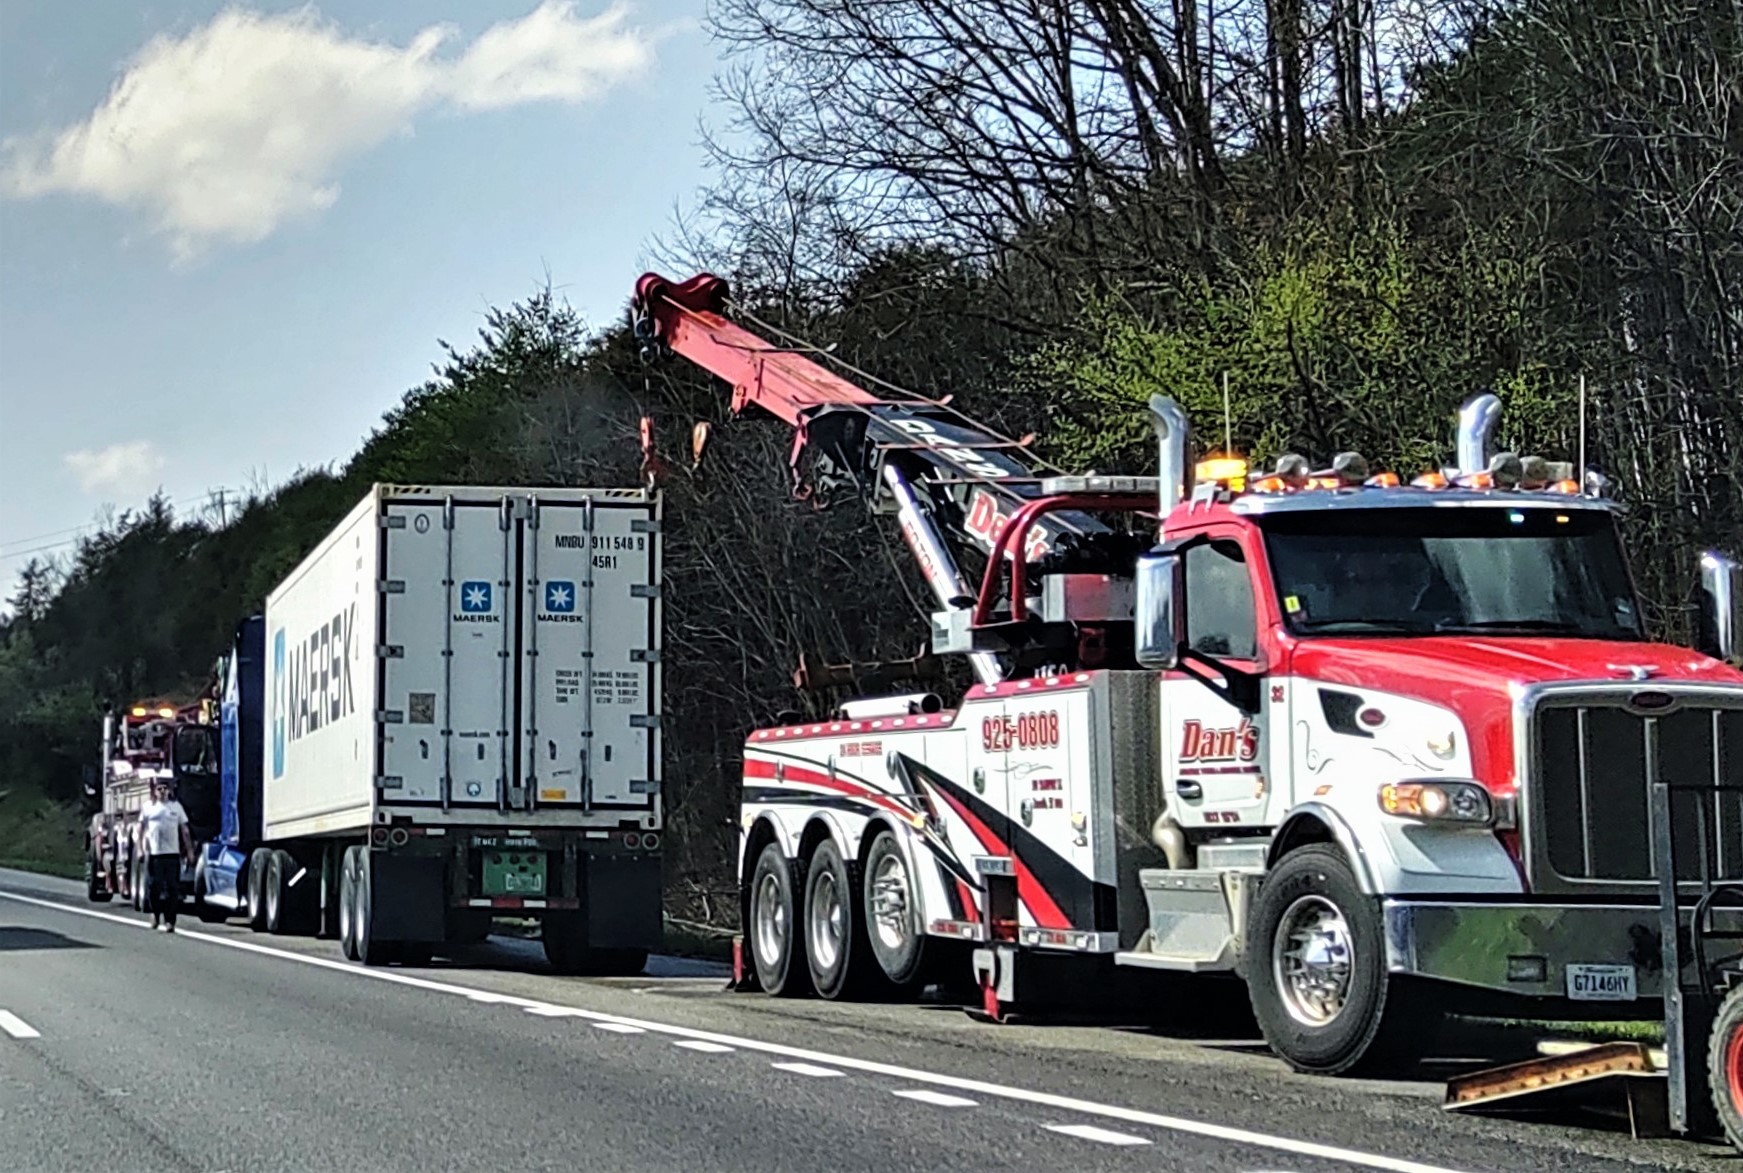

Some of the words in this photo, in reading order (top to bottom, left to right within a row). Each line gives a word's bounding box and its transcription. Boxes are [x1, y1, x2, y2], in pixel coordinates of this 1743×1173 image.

[592, 536, 610, 550] 911
[614, 536, 634, 550] 548
[637, 537, 645, 550] 9
[592, 555, 617, 569] 45R1
[453, 614, 500, 622] MAERSK
[537, 614, 584, 623] MAERSK
[288, 601, 355, 743] MAERSK
[982, 709, 1060, 753] 925-0808
[1179, 718, 1260, 764] Dan's
[1574, 974, 1629, 993] G7146HY
